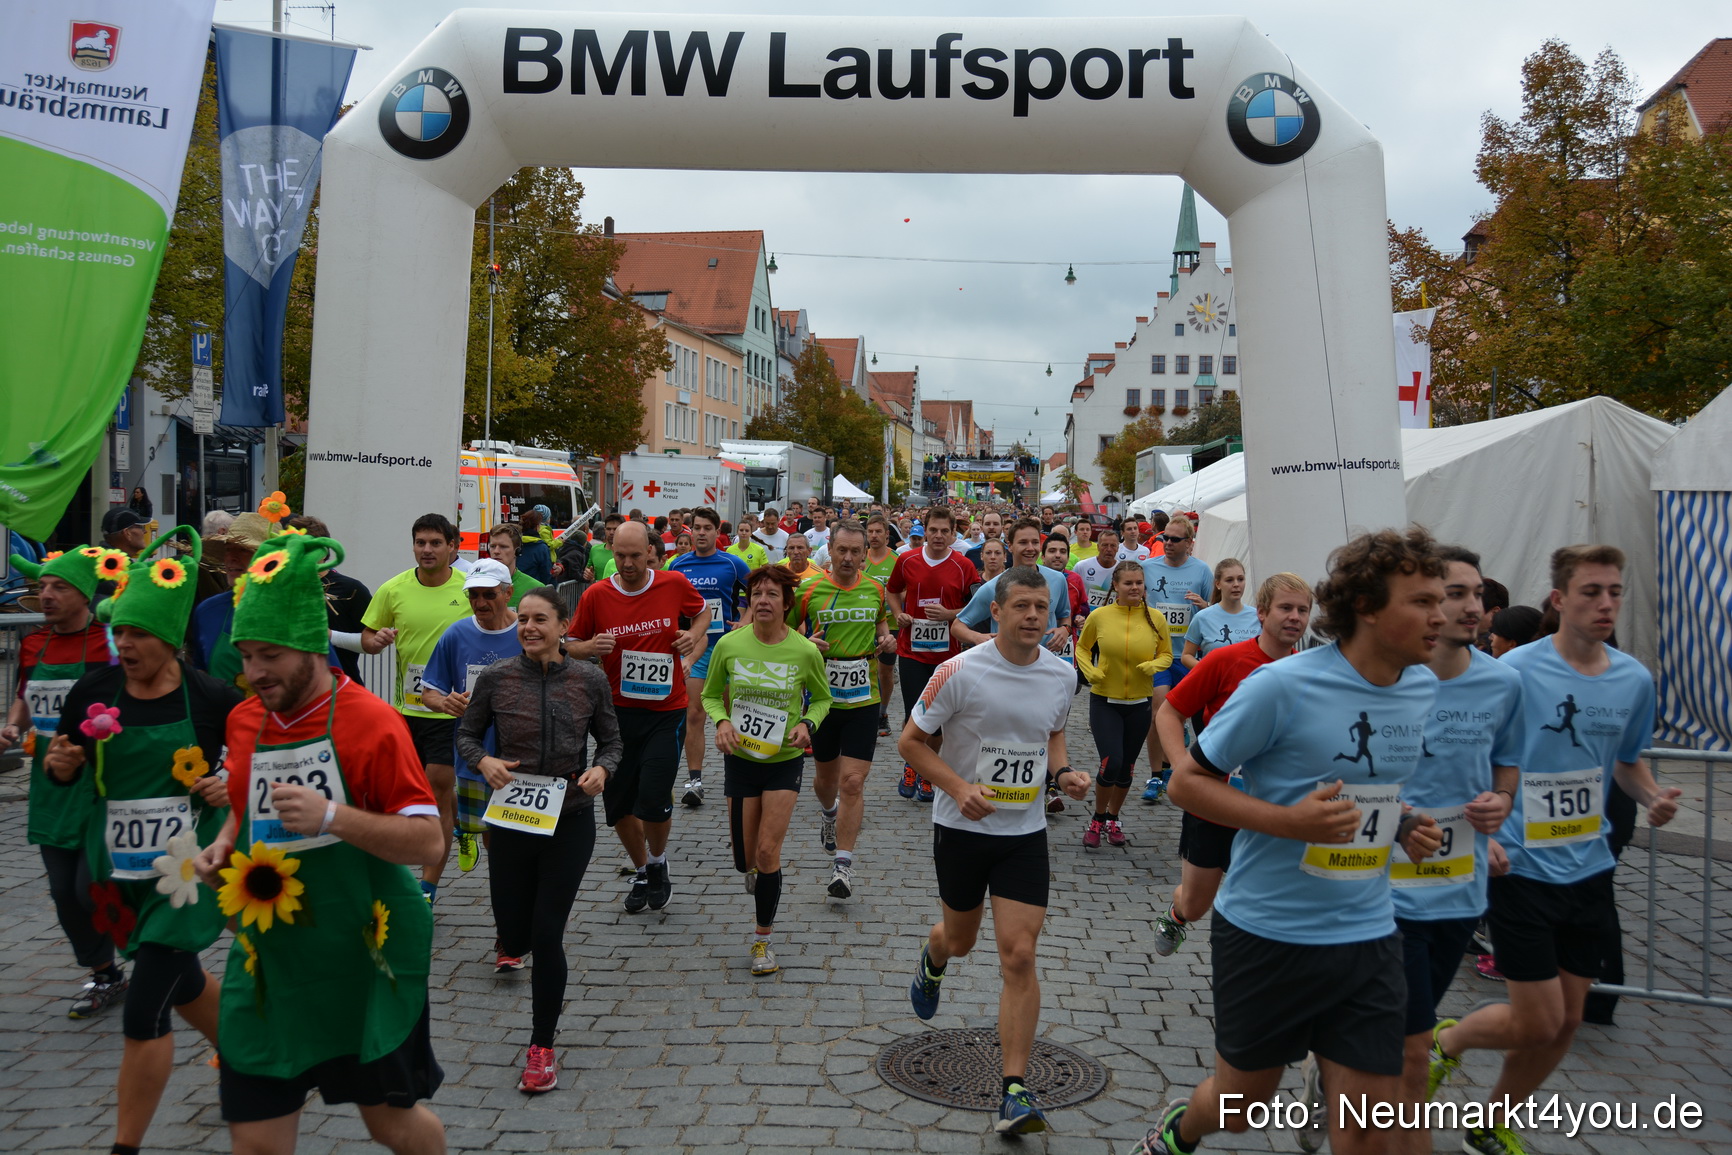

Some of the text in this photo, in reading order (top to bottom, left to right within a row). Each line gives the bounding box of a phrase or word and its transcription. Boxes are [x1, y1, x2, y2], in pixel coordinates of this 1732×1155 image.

[502, 27, 1195, 117] BMW Laufsport
[391, 69, 462, 99] BMW
[1235, 74, 1310, 104] BMW
[240, 159, 302, 195] THE
[227, 198, 282, 231] WAY
[149, 446, 155, 461] 3
[309, 450, 433, 467] www.bmw-laufsport.de
[1271, 457, 1400, 475] www.bmw-laufsport.de
[687, 577, 718, 585] YSCAD
[817, 608, 877, 624] BOCK
[606, 619, 661, 635] NEUMARKT
[914, 627, 946, 641] 2407
[625, 662, 669, 682] 2129
[788, 665, 799, 690] 2015
[830, 669, 866, 687] 2793
[632, 684, 659, 693] Andreas
[735, 687, 793, 700] ANDKREISLAUF
[31, 694, 64, 714] 214
[733, 703, 779, 719] PARTL Neumarkt
[1436, 710, 1492, 723] GYM HIP
[740, 713, 775, 739] 357
[1381, 725, 1409, 738] GYM
[742, 738, 760, 751] Karin
[981, 747, 1006, 755] PARTL
[253, 756, 314, 772] PARTL Neumarkt
[991, 758, 1034, 784] 218
[522, 780, 555, 788] Neumarkt
[1524, 776, 1593, 787] PARTL Neumarkt
[256, 769, 333, 814] 23
[504, 786, 550, 810] 256
[1329, 793, 1394, 803] ARTL Neumarkt
[131, 805, 174, 816] Neumarkt
[1541, 787, 1590, 818] 150
[501, 809, 541, 825] Rebecca
[1433, 814, 1464, 824] umarkt
[112, 816, 183, 849] 2072
[1551, 823, 1582, 836] Stefan
[1438, 827, 1453, 856] 9
[1328, 852, 1378, 867] Matthias
[1416, 865, 1450, 875] Lukas
